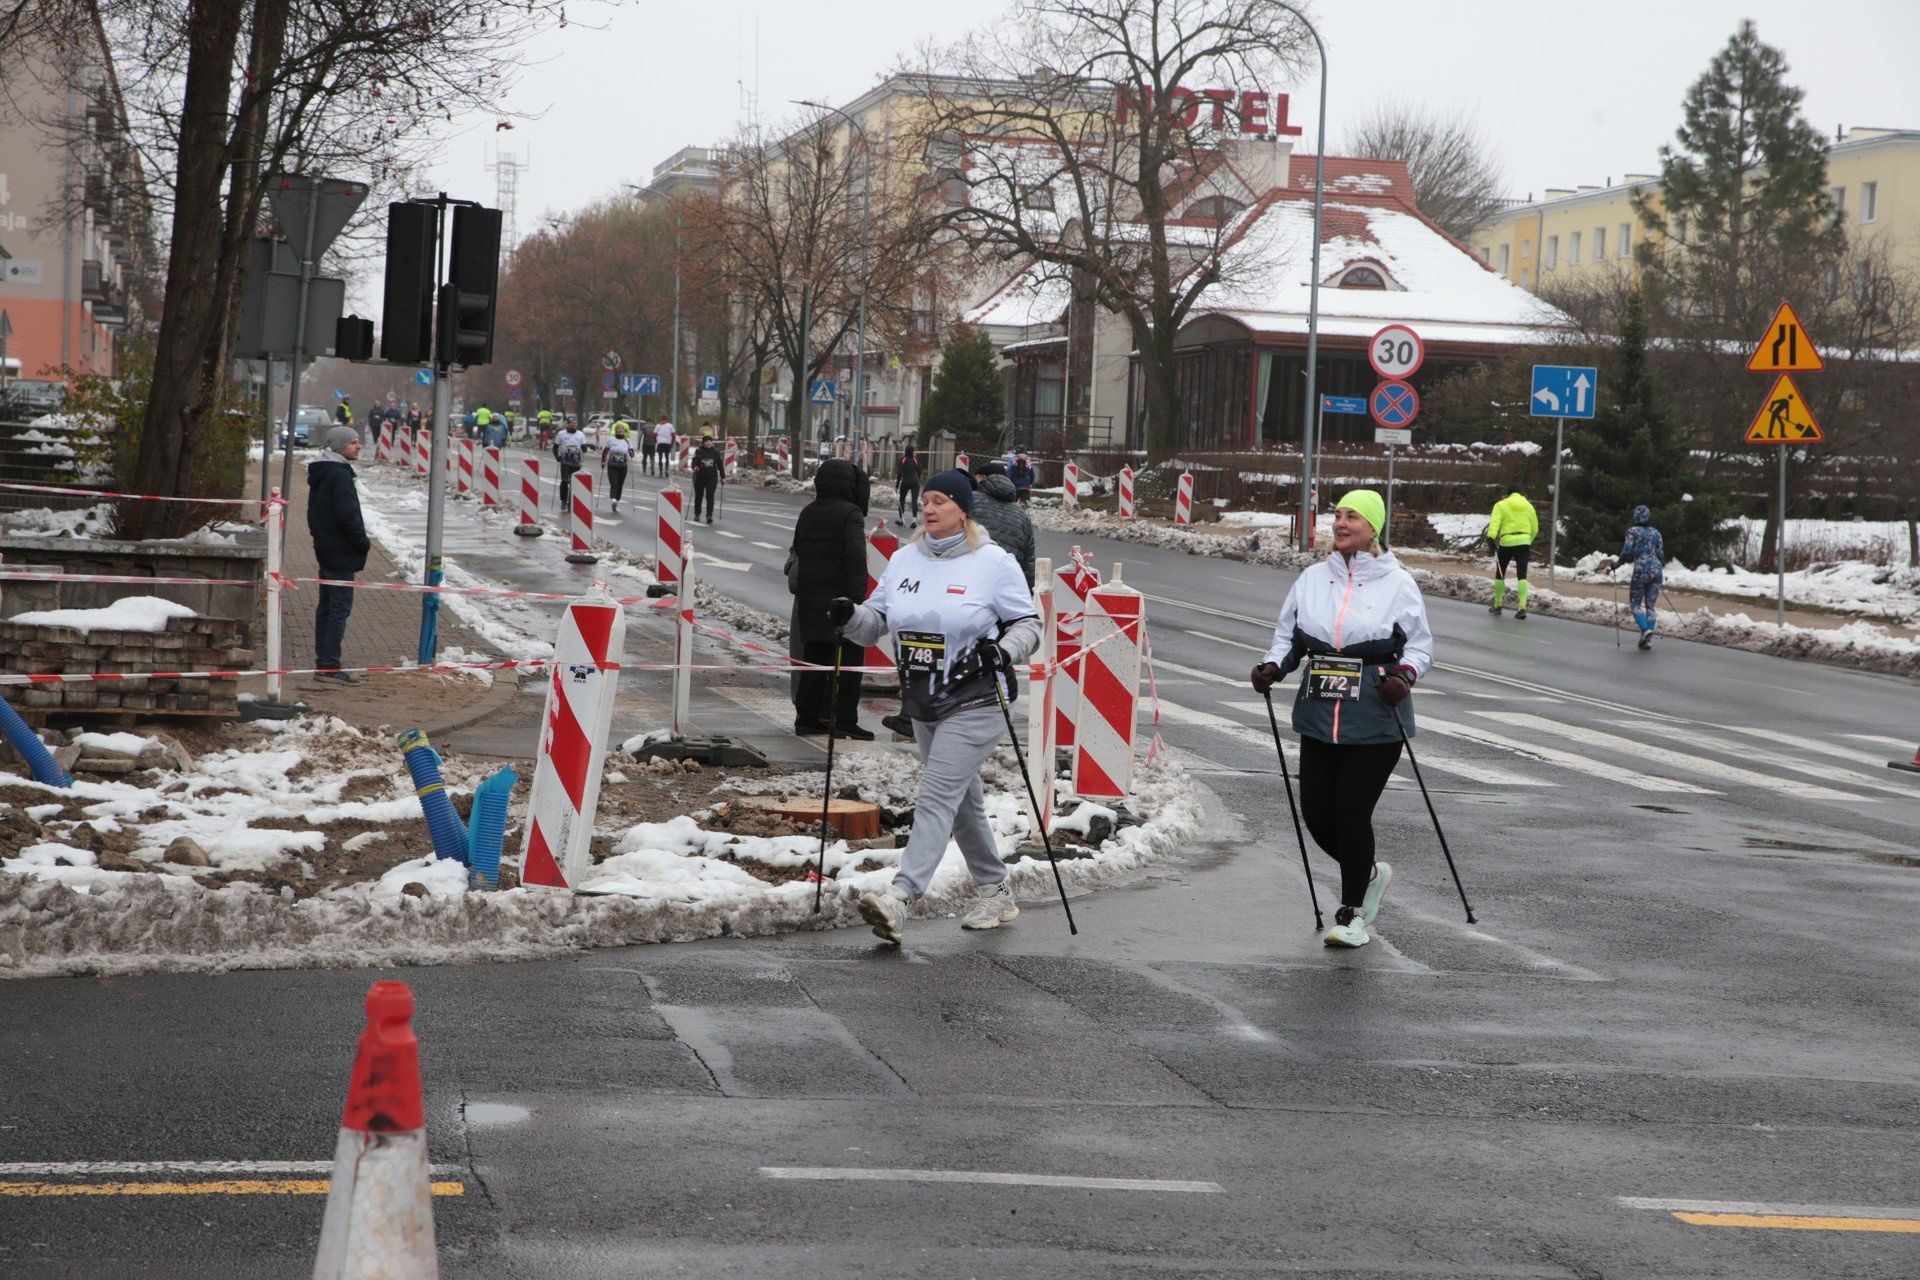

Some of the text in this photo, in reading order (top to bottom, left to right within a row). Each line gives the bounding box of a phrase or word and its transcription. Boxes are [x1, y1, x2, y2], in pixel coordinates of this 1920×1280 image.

[1117, 84, 1303, 136] HOTEL
[1377, 338, 1414, 366] 30
[508, 372, 520, 382] 30
[705, 375, 716, 389] P
[908, 646, 933, 664] 748
[1319, 675, 1348, 691] 772
[1320, 691, 1344, 699] DOROTA
